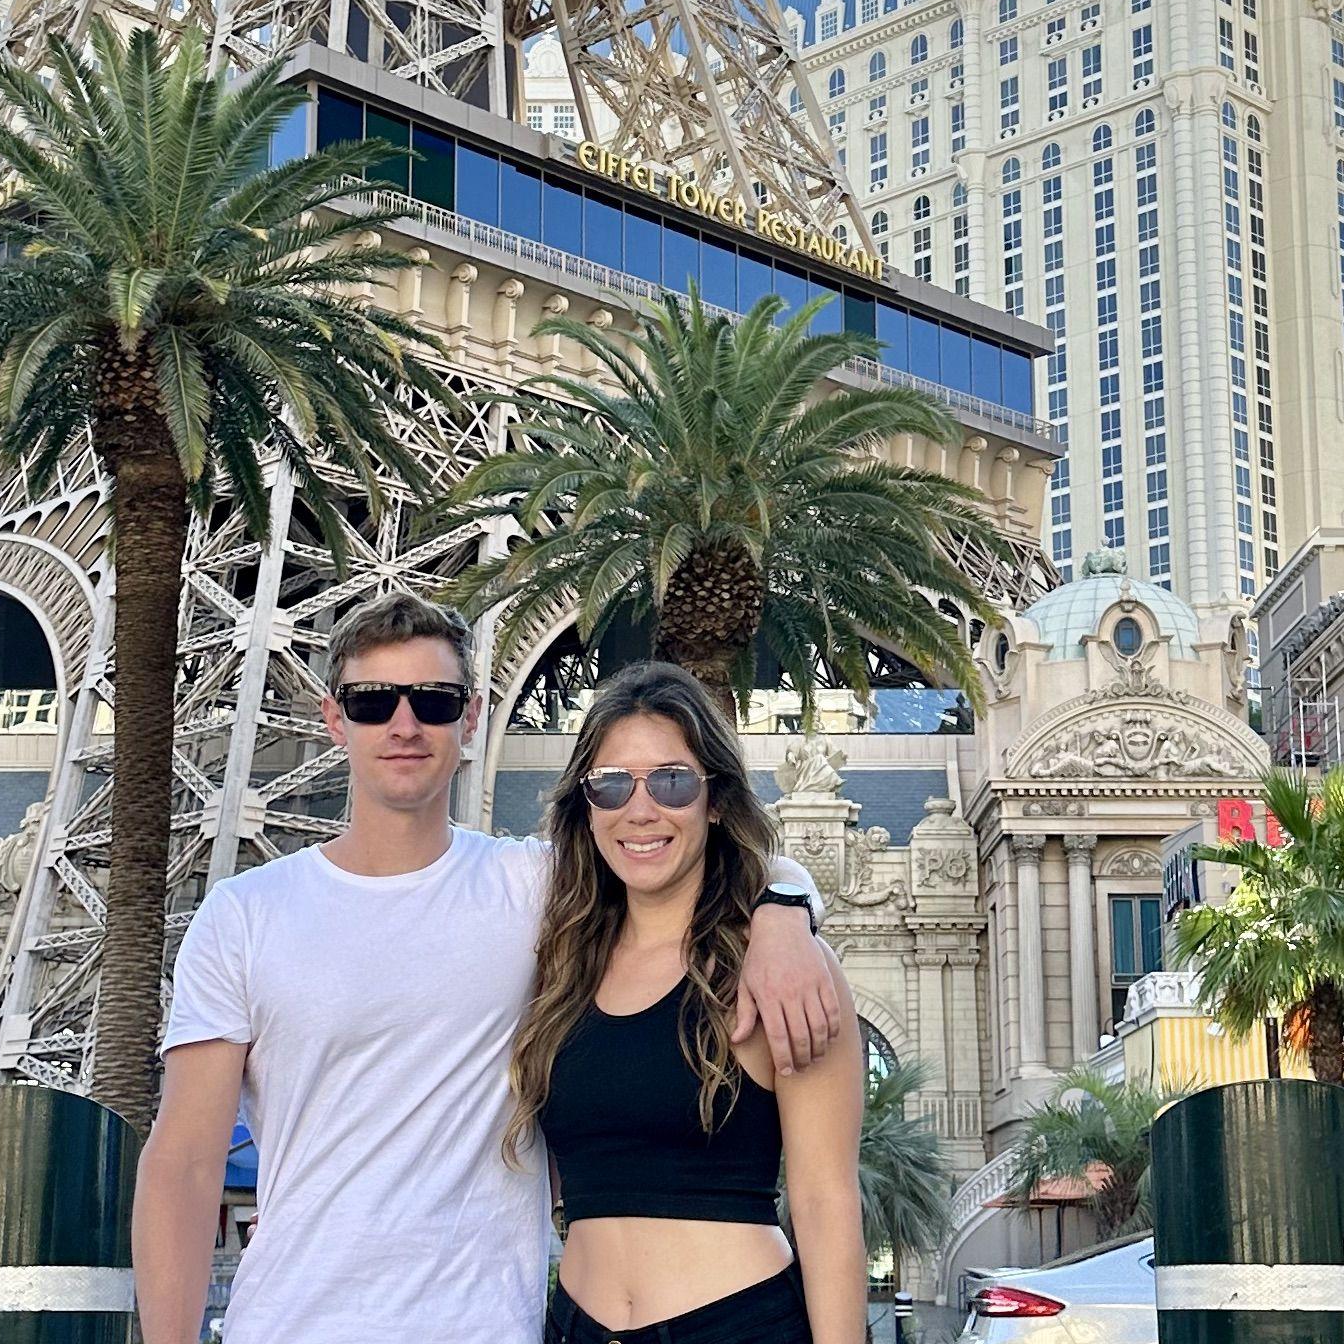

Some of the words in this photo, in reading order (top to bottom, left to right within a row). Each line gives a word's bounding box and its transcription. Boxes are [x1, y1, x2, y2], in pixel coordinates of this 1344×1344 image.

[578, 140, 661, 195] EIFFEL
[667, 174, 748, 228] TOWER
[757, 207, 885, 281] RESTAURANT
